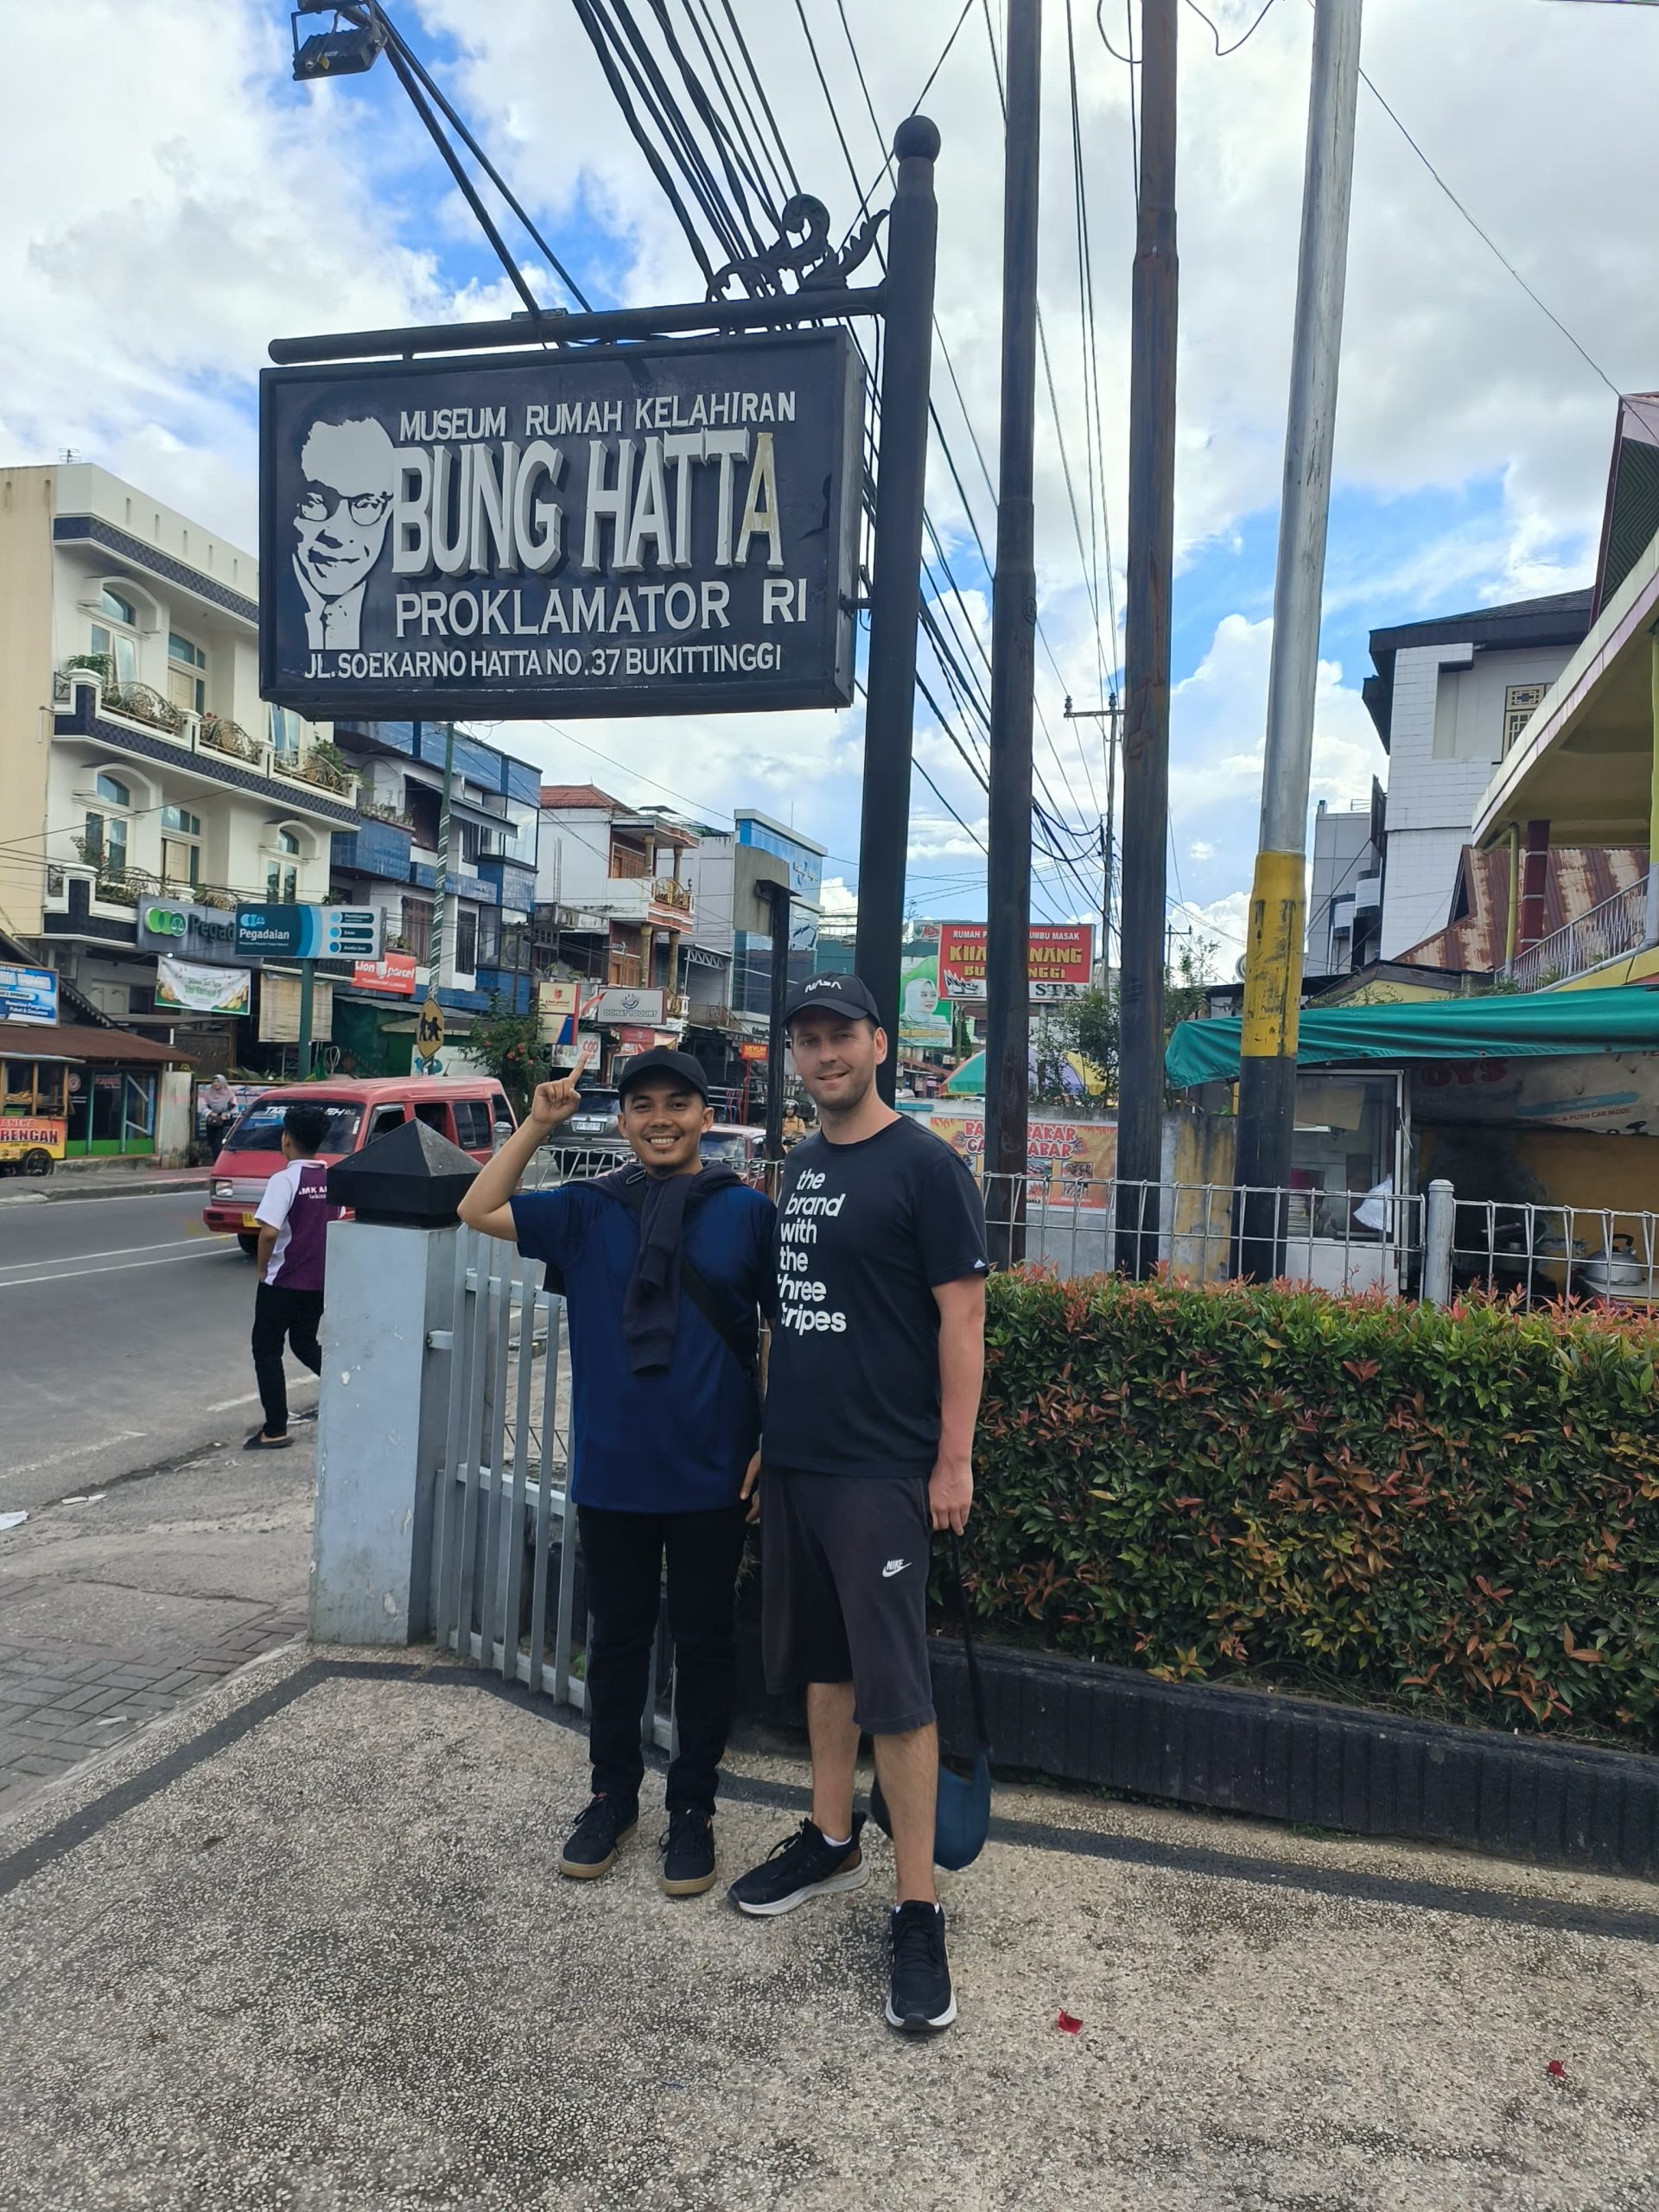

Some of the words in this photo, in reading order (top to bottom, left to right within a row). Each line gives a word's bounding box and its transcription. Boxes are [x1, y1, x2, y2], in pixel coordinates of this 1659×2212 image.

[400, 406, 506, 442] MUSEUM
[524, 400, 623, 437] RUMAH
[635, 391, 797, 429] KELAHIRAN
[391, 439, 563, 577] BUNG
[582, 429, 785, 574] HATTA
[396, 581, 730, 639] PROKLAMATOR
[763, 578, 807, 625] RI
[471, 648, 544, 677] HATTA
[626, 642, 782, 675] BUKITTINGGI
[188, 913, 236, 943] Pegad
[238, 928, 290, 942] Pegadaian
[1052, 932, 1080, 941] MASAK
[355, 960, 375, 973] Lion
[387, 967, 415, 978] parcel
[804, 979, 842, 993] NASA
[1027, 1141, 1073, 1158] ABAR
[796, 1167, 825, 1191] the
[785, 1192, 846, 1217] brand
[780, 1217, 817, 1244] with
[779, 1245, 809, 1272] the
[781, 1302, 847, 1336] ripes
[886, 1559, 905, 1571] NIKE
